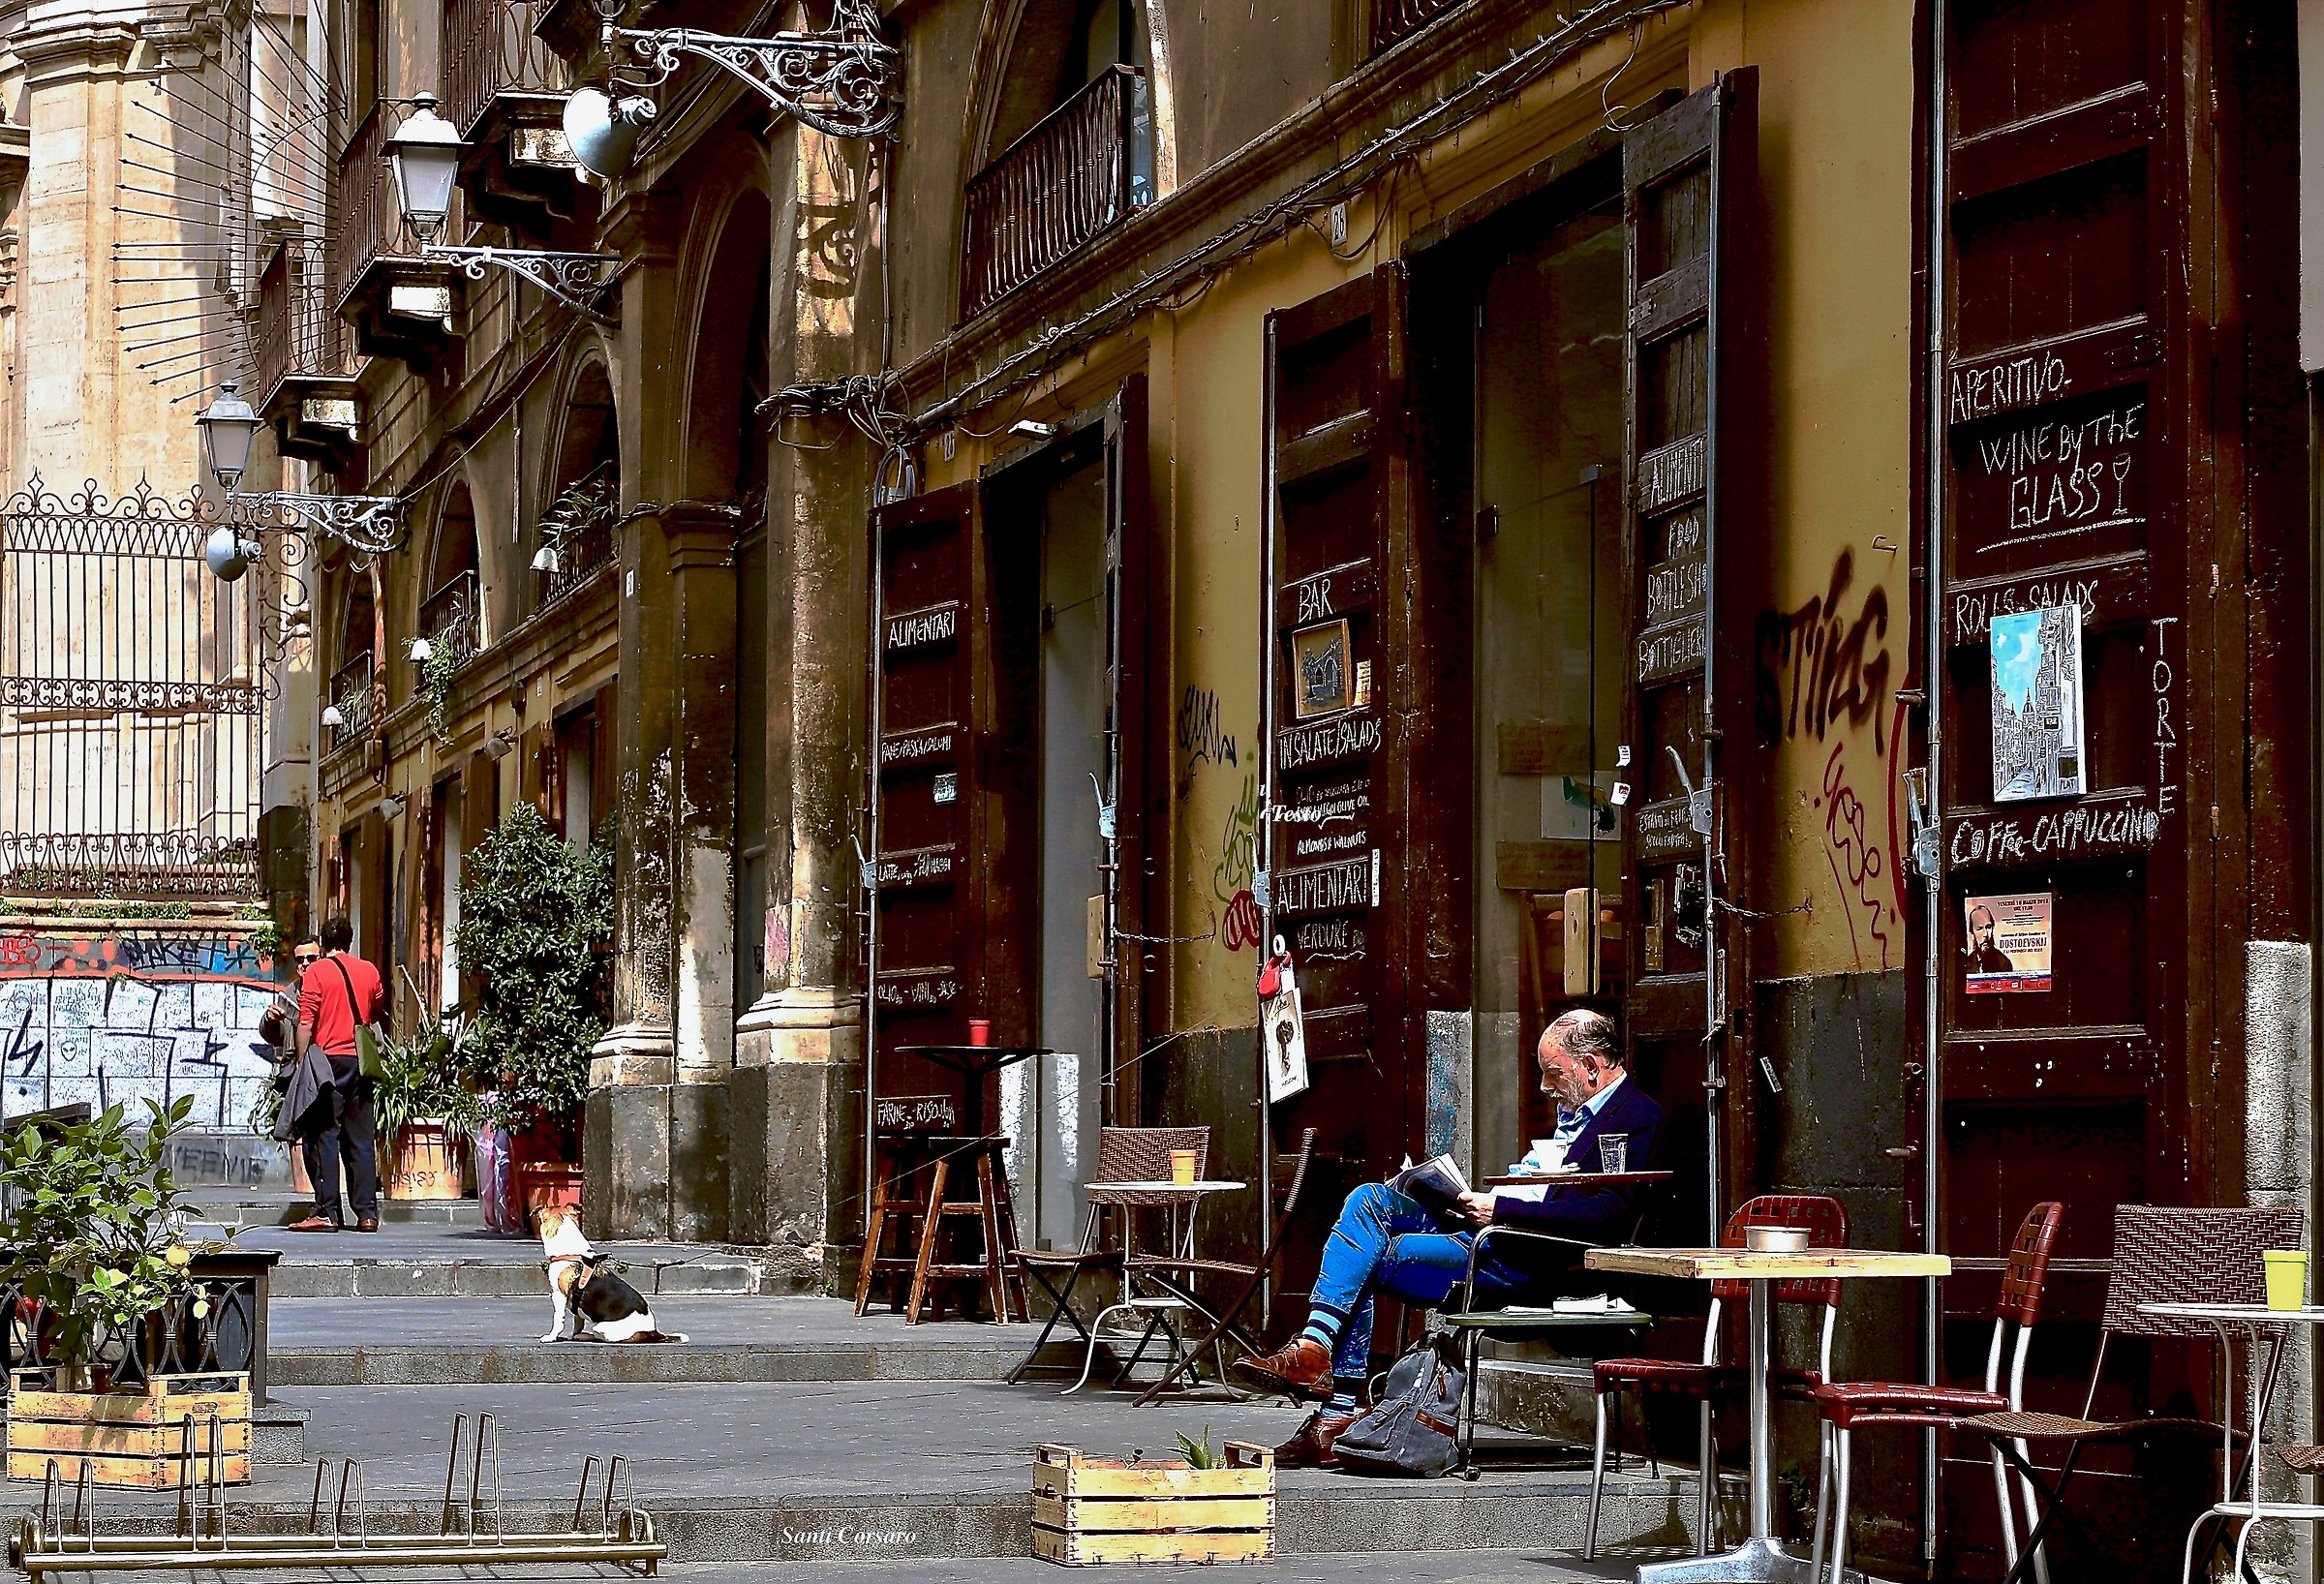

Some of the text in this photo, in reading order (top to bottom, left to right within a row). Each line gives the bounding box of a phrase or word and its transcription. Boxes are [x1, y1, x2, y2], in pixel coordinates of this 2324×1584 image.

[1979, 423, 2054, 475] WINE
[2010, 462, 2103, 530] GLASS
[1298, 578, 1333, 624] BAR
[1687, 562, 1708, 603] SHO
[888, 610, 956, 650] ALIMENTARI
[2152, 617, 2179, 816] TORTE
[1276, 864, 1367, 914] ALIMENTARI
[2000, 937, 2048, 949] DOSTOEVSKIJ
